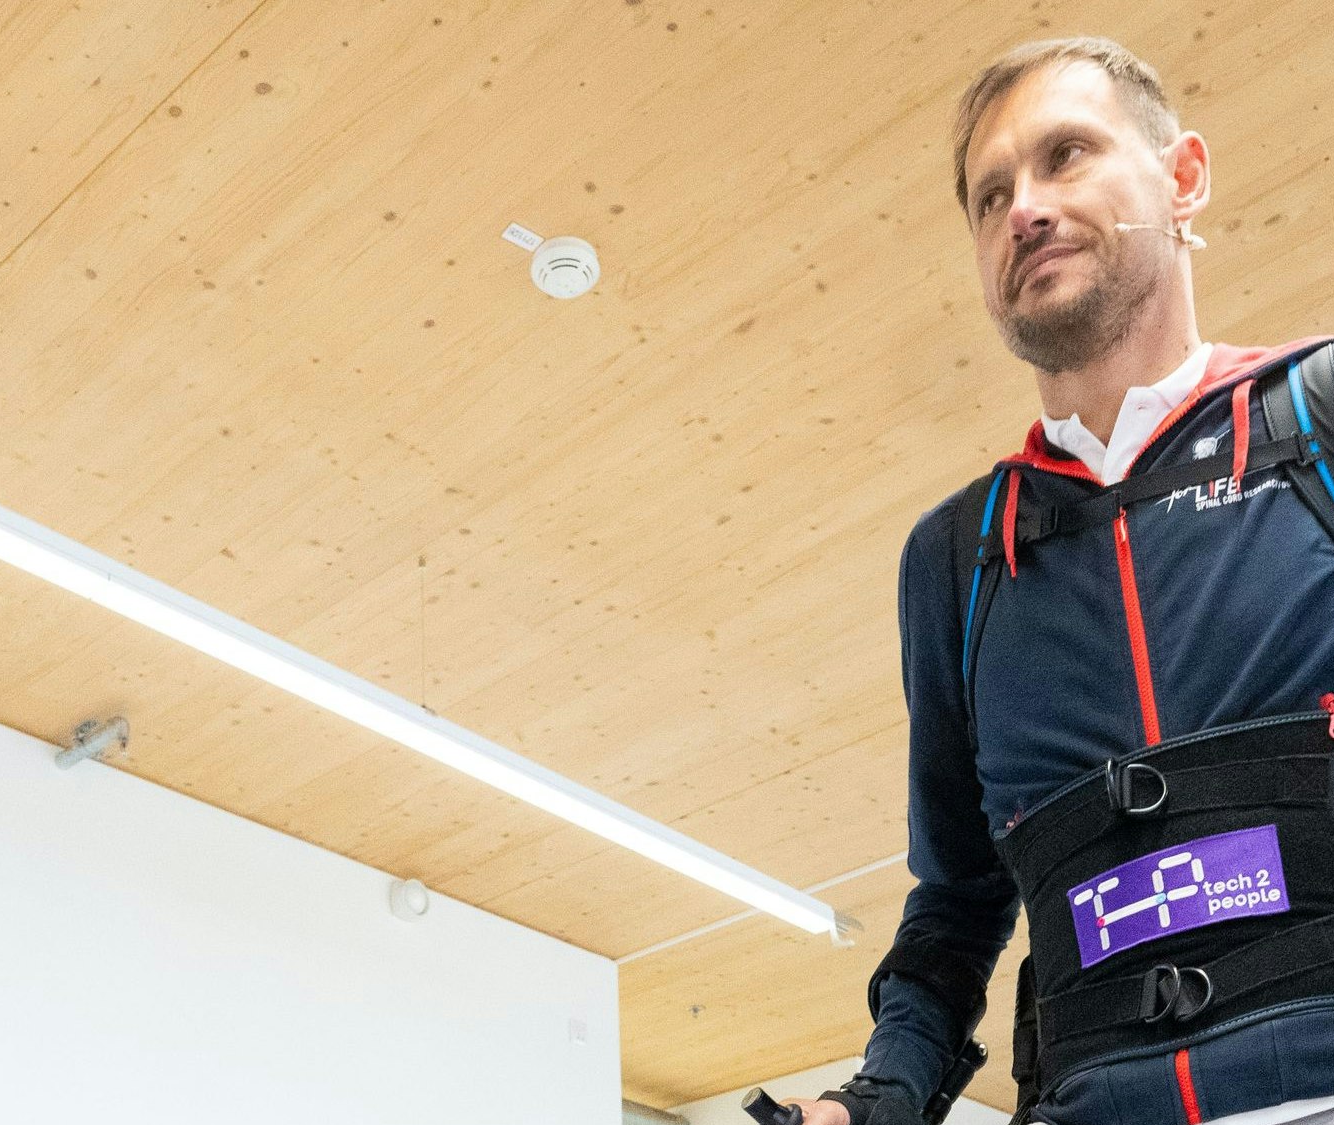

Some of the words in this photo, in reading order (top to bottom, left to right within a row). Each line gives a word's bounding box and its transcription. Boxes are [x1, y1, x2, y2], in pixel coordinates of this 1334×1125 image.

[1196, 498, 1222, 511] SPINAL
[1223, 493, 1243, 505] CORD
[1202, 873, 1252, 896] tech
[1256, 869, 1270, 887] 2
[1208, 888, 1281, 915] people
